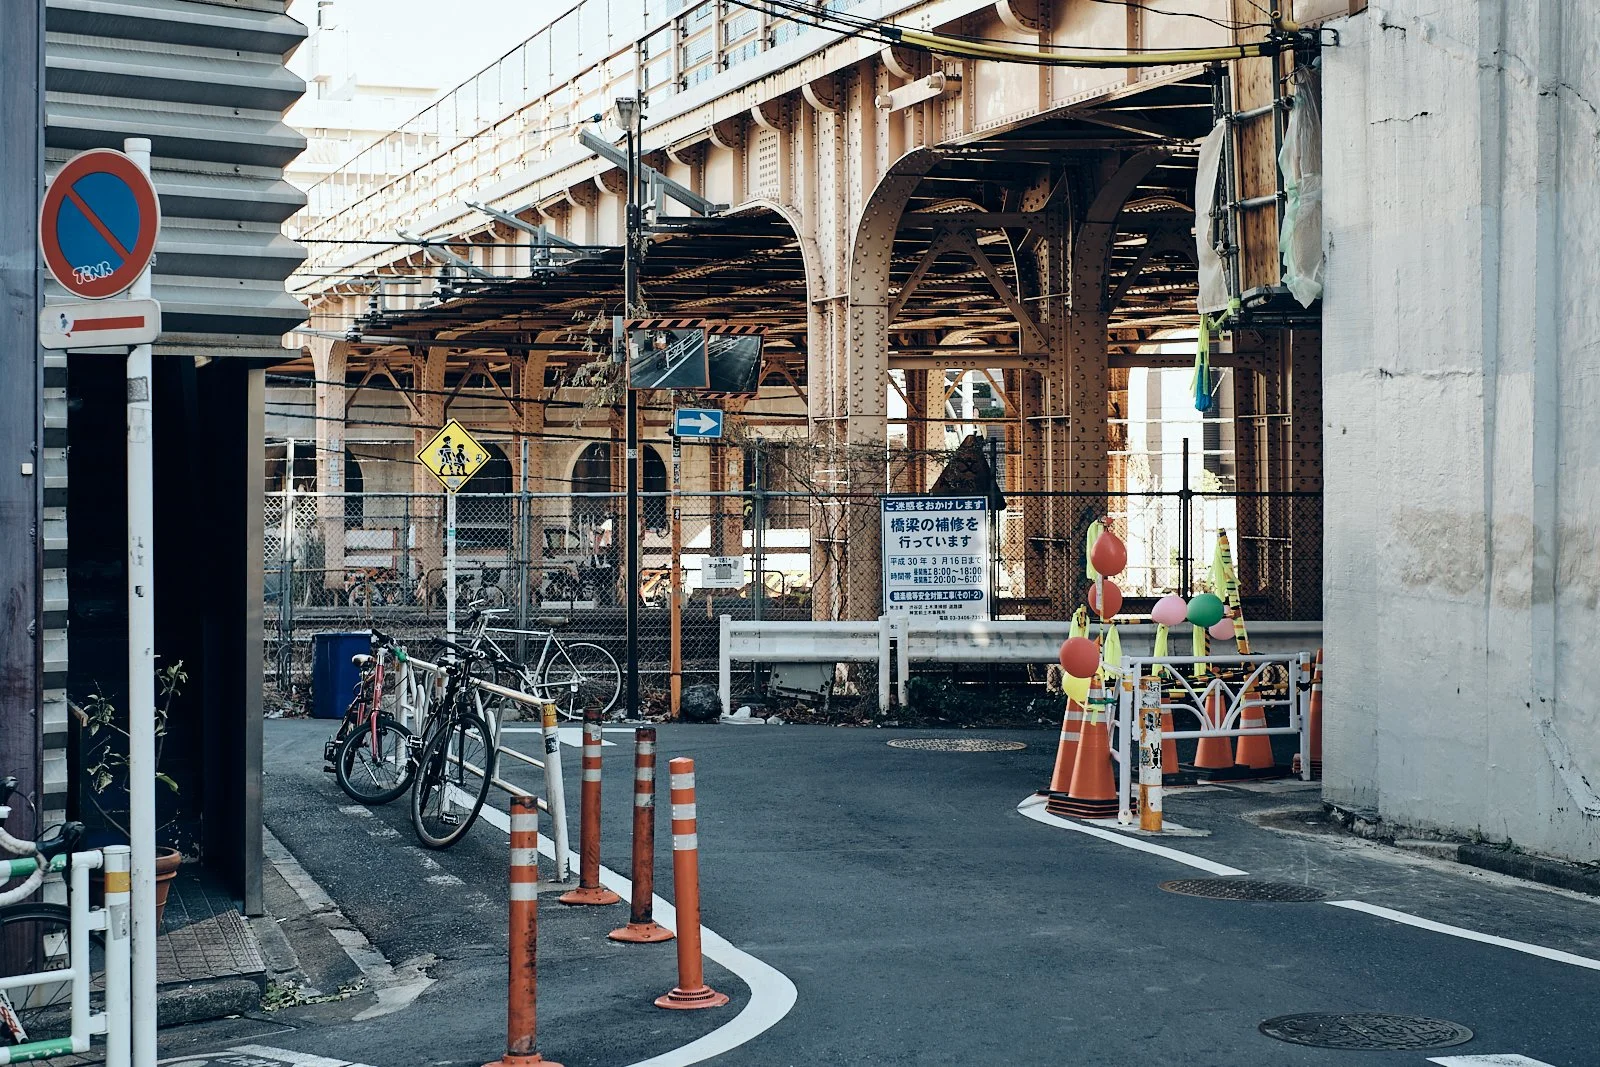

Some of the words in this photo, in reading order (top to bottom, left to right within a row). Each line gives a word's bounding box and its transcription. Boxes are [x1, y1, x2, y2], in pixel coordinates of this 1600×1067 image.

[885, 501, 984, 511] ご迷惑をおかけします
[890, 517, 979, 533] 橋梁の補修を
[898, 535, 972, 549] 行っています
[890, 572, 912, 581] 時間帯
